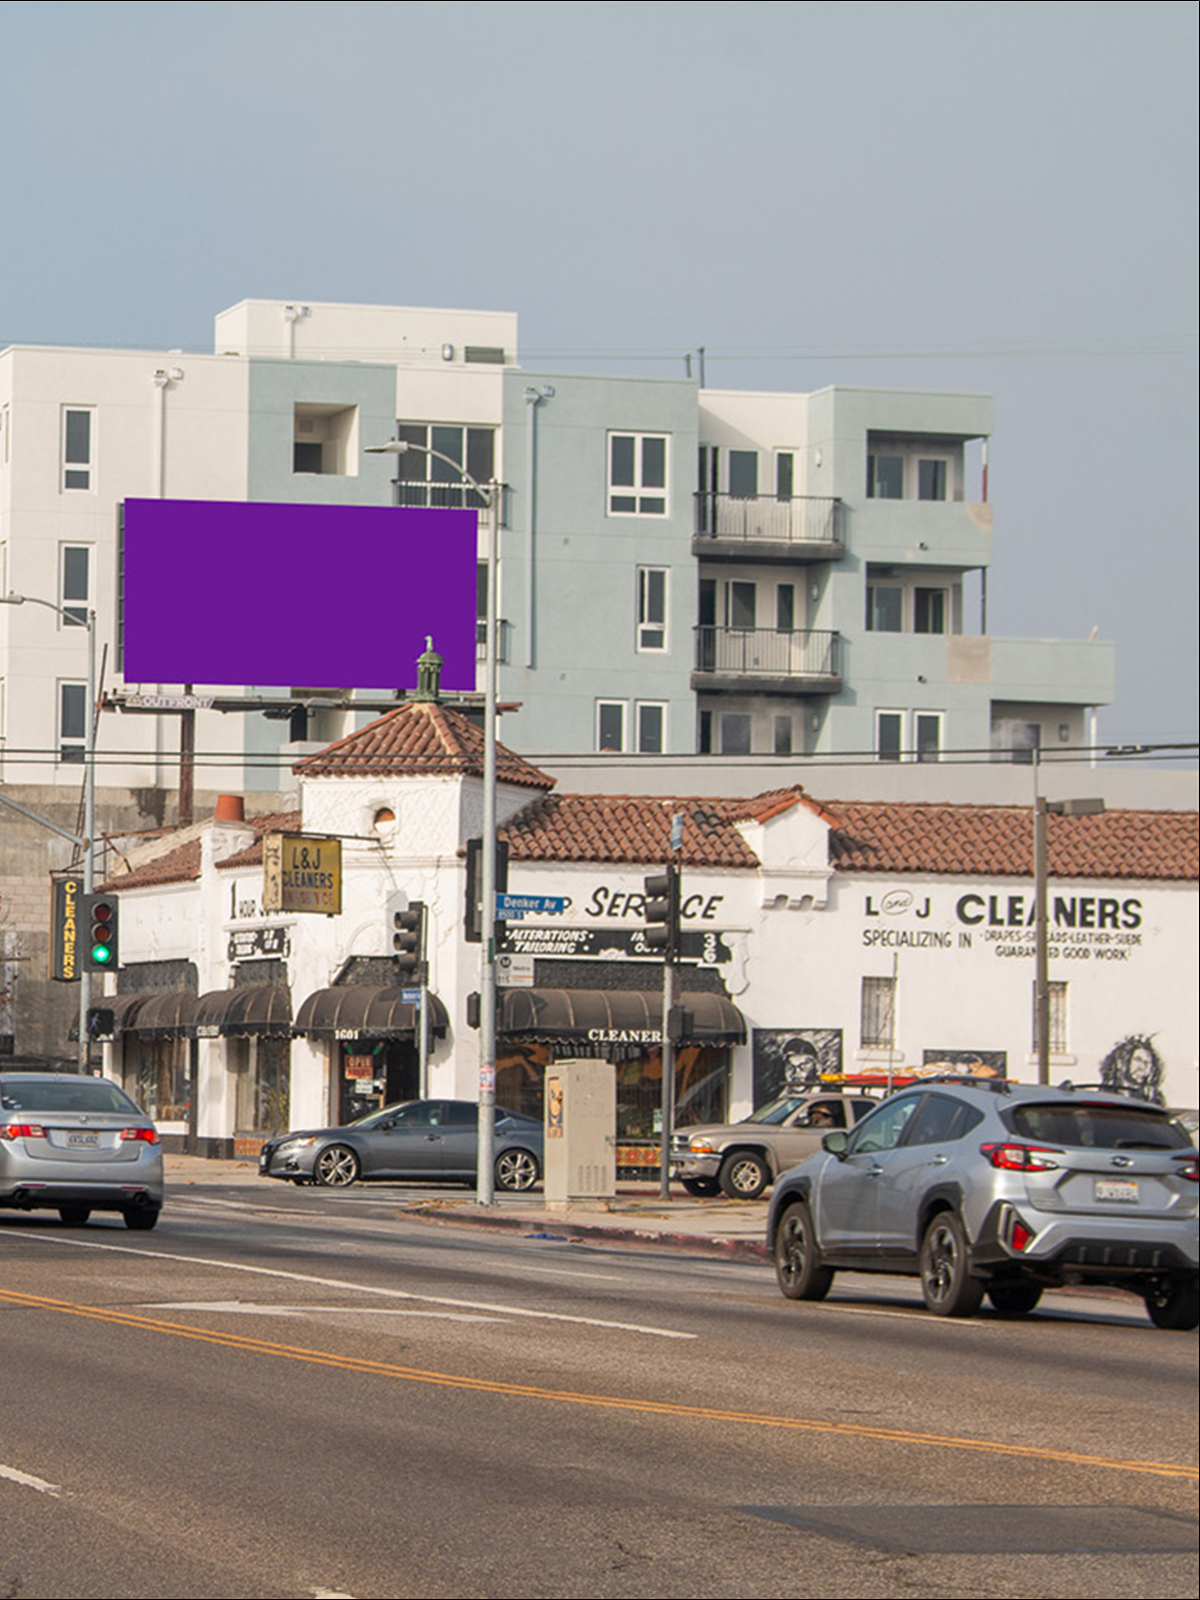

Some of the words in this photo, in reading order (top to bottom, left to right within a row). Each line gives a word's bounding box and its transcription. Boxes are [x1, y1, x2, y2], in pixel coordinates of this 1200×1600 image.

[292, 846, 322, 870] L&J
[282, 870, 334, 890] CLEANERS
[503, 896, 540, 909] Denker
[543, 898, 556, 909] Av
[585, 886, 723, 919] SERCE
[865, 896, 879, 916] L
[915, 897, 931, 919] J
[63, 881, 77, 979] CLEANERS
[508, 929, 588, 942] ALTERATIONS
[862, 929, 952, 948] SPECIALIZING
[958, 932, 971, 948] IN
[514, 941, 576, 953] TAILORING
[995, 945, 1059, 958] GUARANED
[1063, 946, 1091, 959] GOOD
[1094, 948, 1128, 961] WORK
[335, 1029, 358, 1040] 1601
